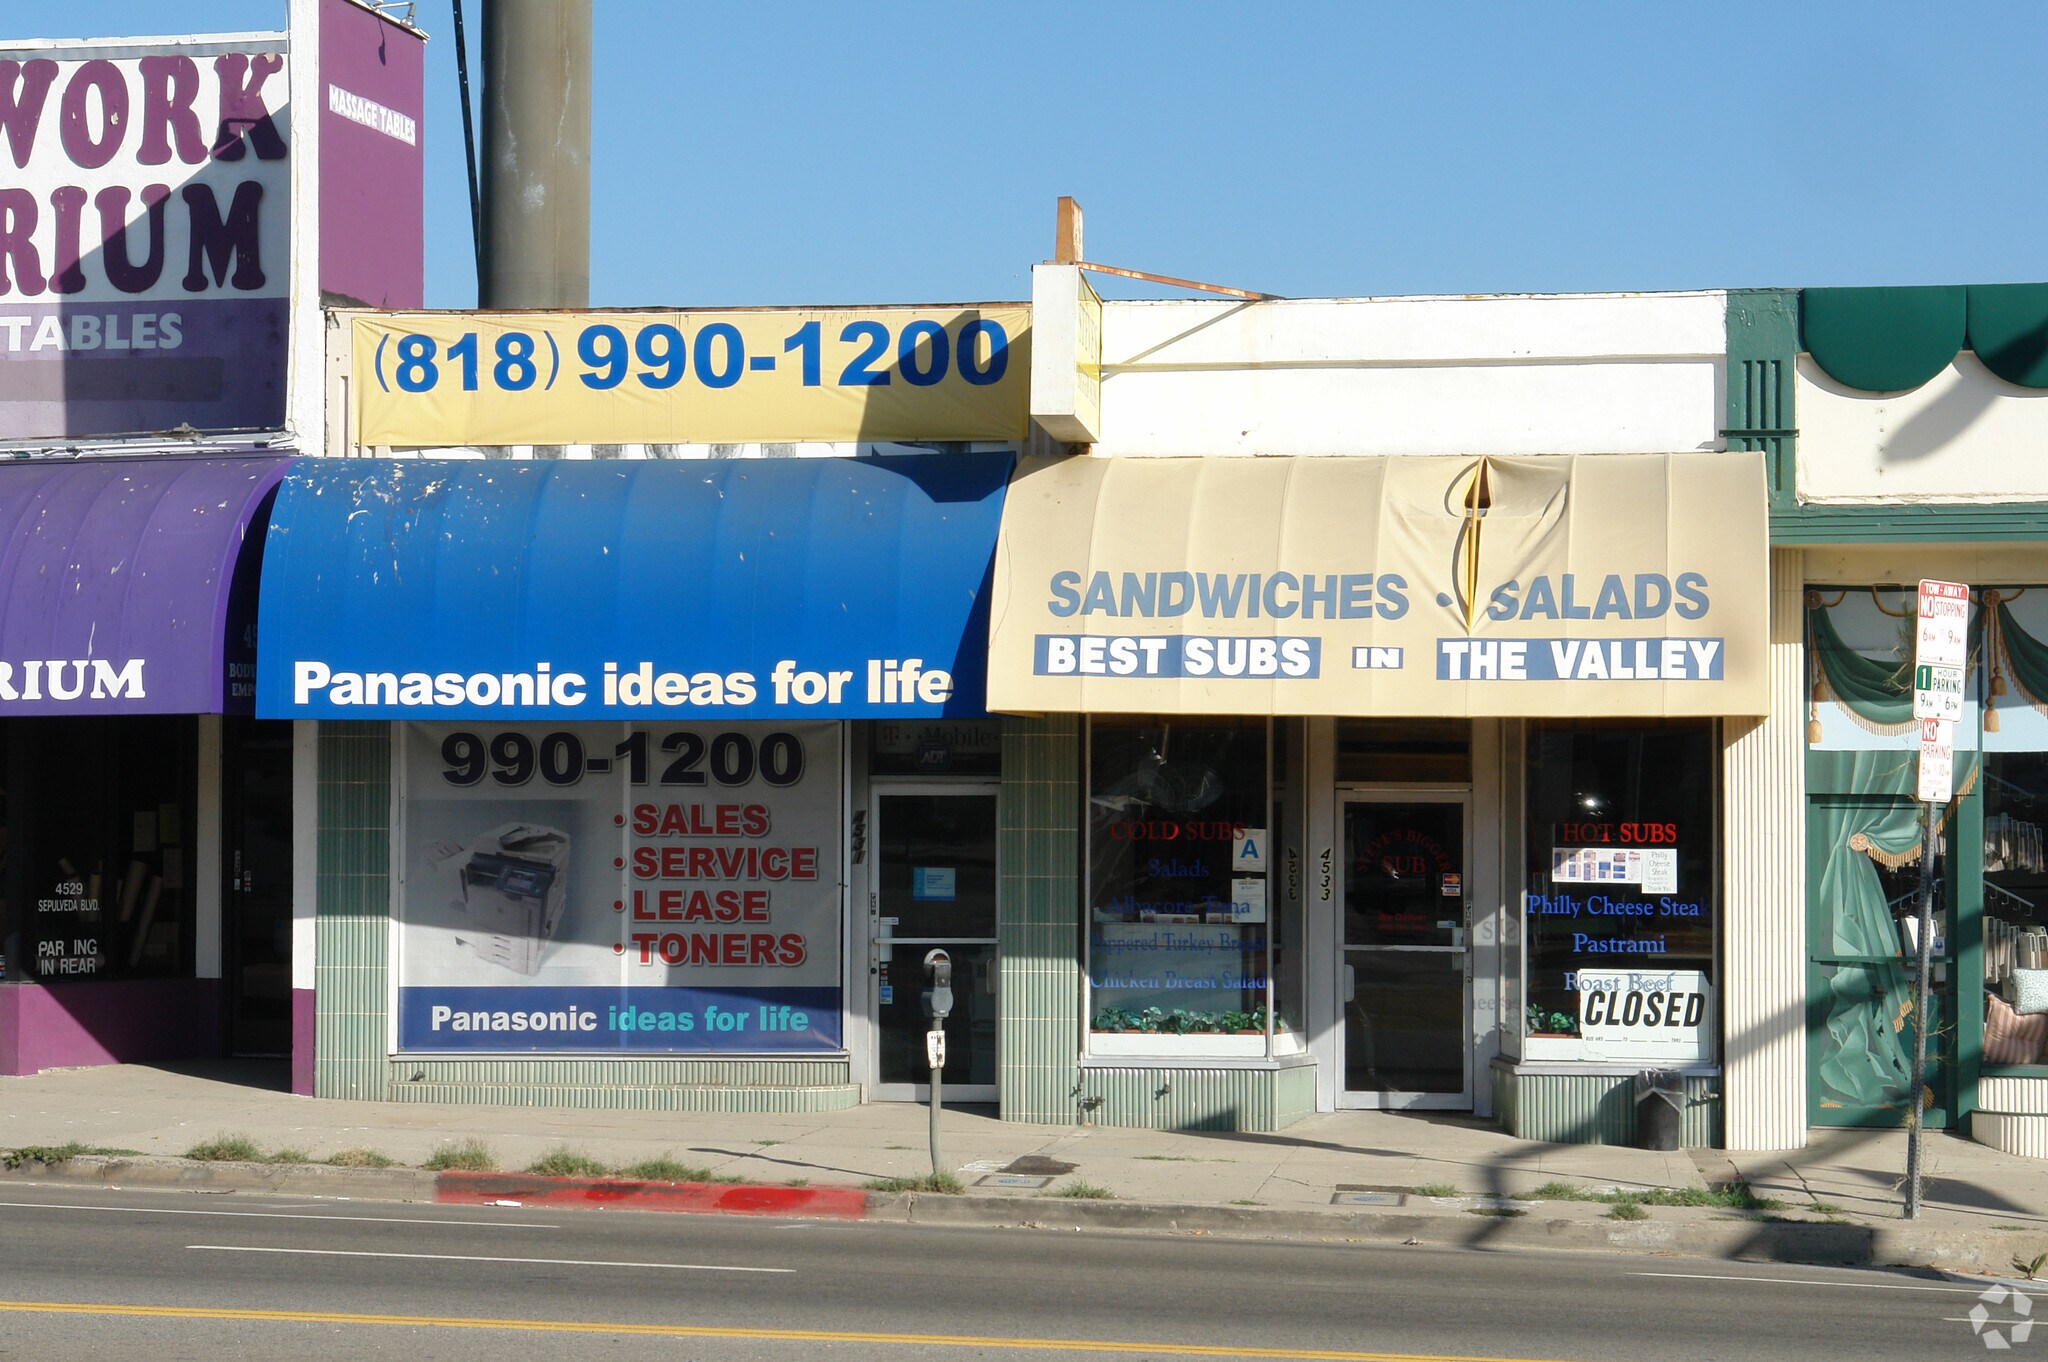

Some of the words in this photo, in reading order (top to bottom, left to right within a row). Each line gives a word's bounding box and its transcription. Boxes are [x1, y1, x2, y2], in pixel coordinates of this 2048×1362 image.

[329, 84, 378, 128] MASSAGE
[379, 107, 415, 145] TABLES
[0, 313, 183, 351] TABLES
[375, 330, 559, 394] (818)
[577, 319, 1010, 390] 990-1200
[1047, 570, 1409, 620] SANDWICHES
[1487, 571, 1710, 621] SALADS
[1924, 582, 1963, 598] TOW-AWAY
[1920, 595, 1934, 617] NO
[1936, 601, 1965, 618] STOPPING
[1047, 637, 1169, 676] BEST
[1184, 637, 1311, 677] SUBS
[1354, 648, 1401, 667] IN
[1441, 640, 1527, 680] THE
[1551, 640, 1721, 680] VALLEY
[294, 661, 587, 706] Panasonic
[603, 661, 757, 706] ideas
[771, 660, 852, 706] for
[867, 658, 953, 705] life
[1922, 668, 1927, 688] 1
[1938, 669, 1957, 678] HOUR
[1933, 677, 1962, 694] PARKING
[1923, 721, 1937, 740] NO
[440, 731, 805, 787] 990-1200
[1922, 743, 1950, 760] PARKING
[632, 803, 771, 838] SALES
[1109, 820, 1180, 841] COLD
[1184, 819, 1246, 841] SUBS
[1563, 822, 1614, 843] HOT
[1619, 822, 1677, 843] SUBS
[1240, 838, 1259, 859] A
[1406, 828, 1454, 873] BIGGER
[632, 846, 819, 882] SERVICE
[1149, 857, 1210, 878] Salads
[1320, 847, 1332, 901] 4533
[1382, 855, 1425, 875] SUB
[55, 883, 84, 895] 4529
[38, 899, 78, 912] SEPULVEDA
[80, 899, 100, 911] BLVD.
[632, 889, 770, 923] LEASE
[1106, 895, 1196, 915] Albacore
[1201, 895, 1251, 915] Tuna
[1527, 894, 1581, 919] Philly
[1587, 895, 1654, 916] Cheese
[632, 933, 808, 968] TONERS
[1162, 932, 1214, 955] Turkey
[1572, 932, 1666, 953] Pastrami
[41, 959, 55, 975] IN
[60, 958, 96, 974] REAR
[1090, 968, 1160, 989] Chicken
[1164, 970, 1217, 989] Breast
[1563, 971, 1621, 992] Roast
[1627, 971, 1676, 992] Beef
[432, 1006, 598, 1033] Panasonic
[609, 1006, 694, 1033] ideas
[704, 1006, 750, 1033] for
[760, 1006, 810, 1033] life
[1584, 991, 1706, 1027] CLOSED
